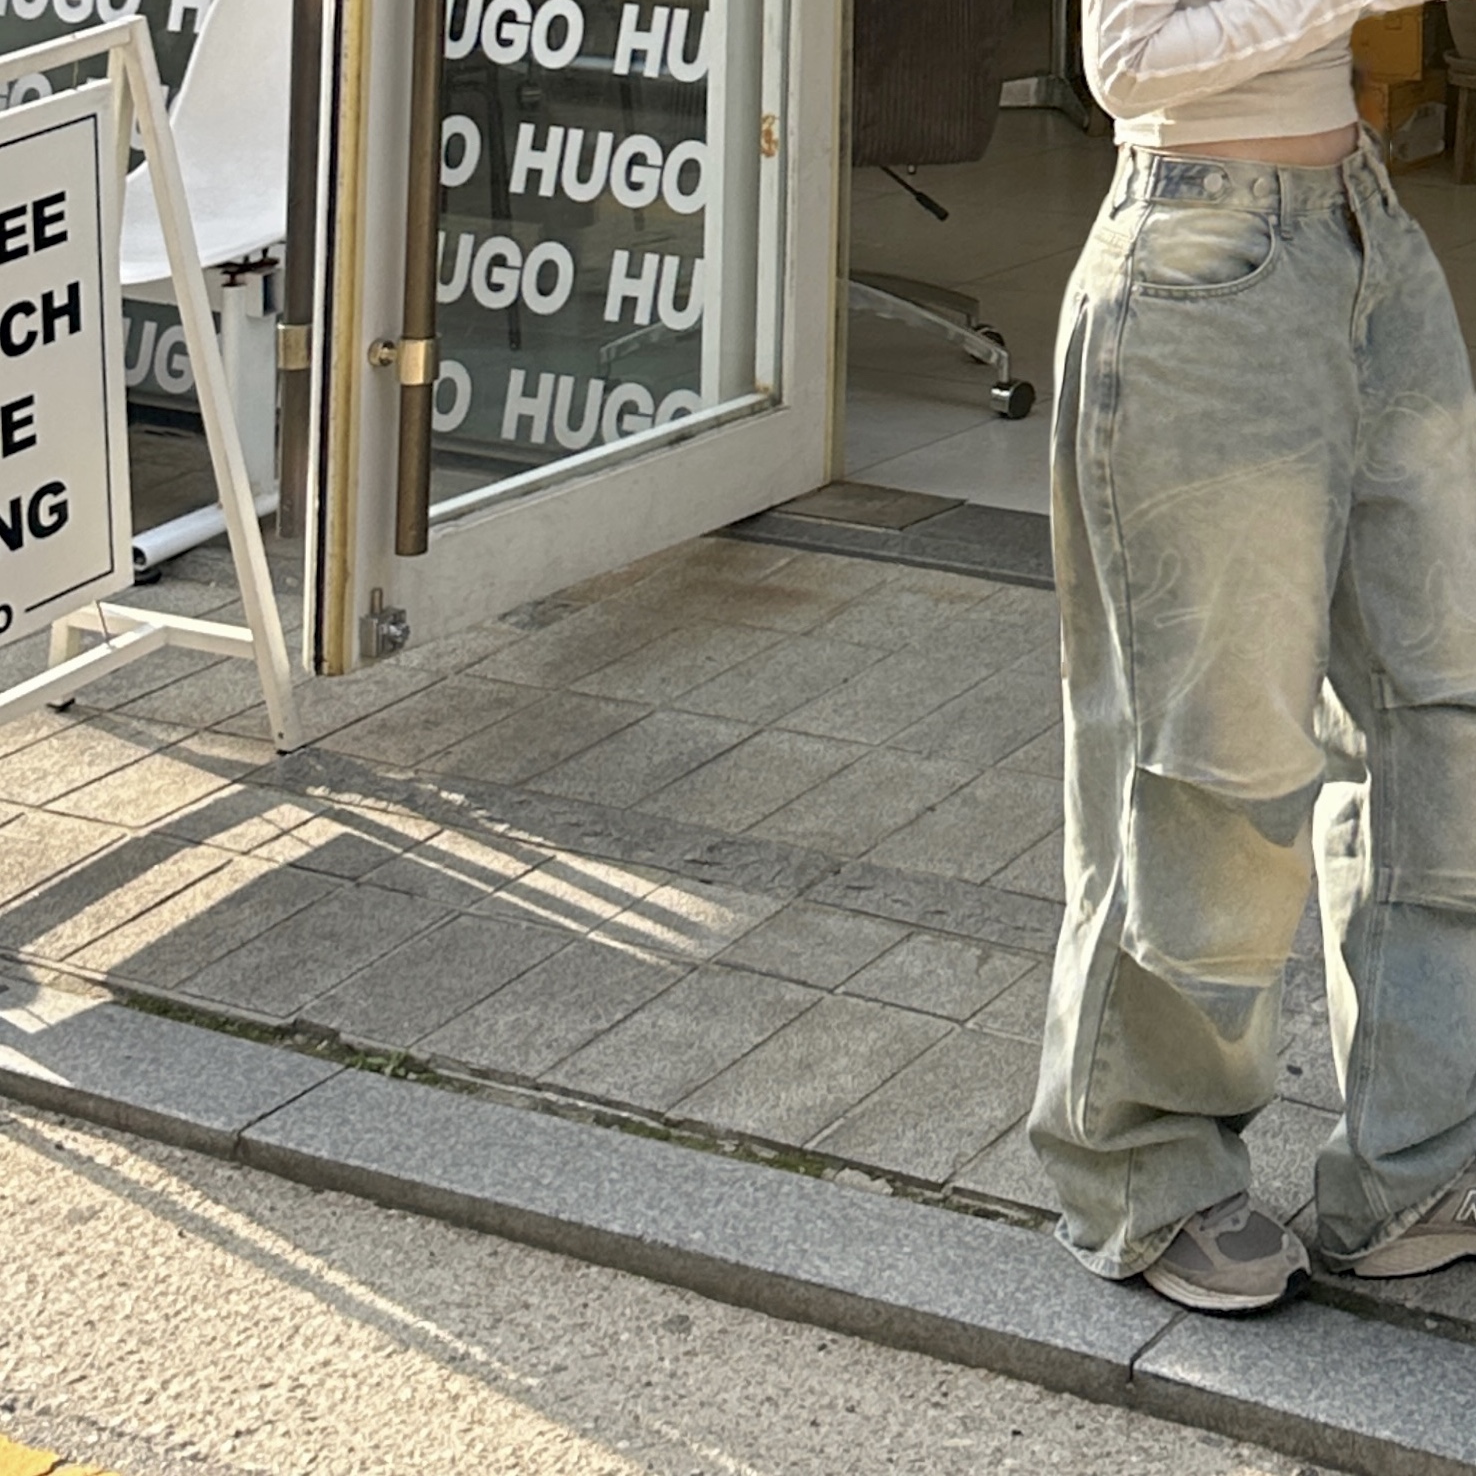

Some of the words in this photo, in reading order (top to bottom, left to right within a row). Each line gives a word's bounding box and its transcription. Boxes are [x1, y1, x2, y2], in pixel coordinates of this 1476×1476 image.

[613, 3, 709, 83] HU
[509, 123, 708, 215] HUGO
[437, 231, 575, 315] UGO
[604, 250, 704, 330] HU
